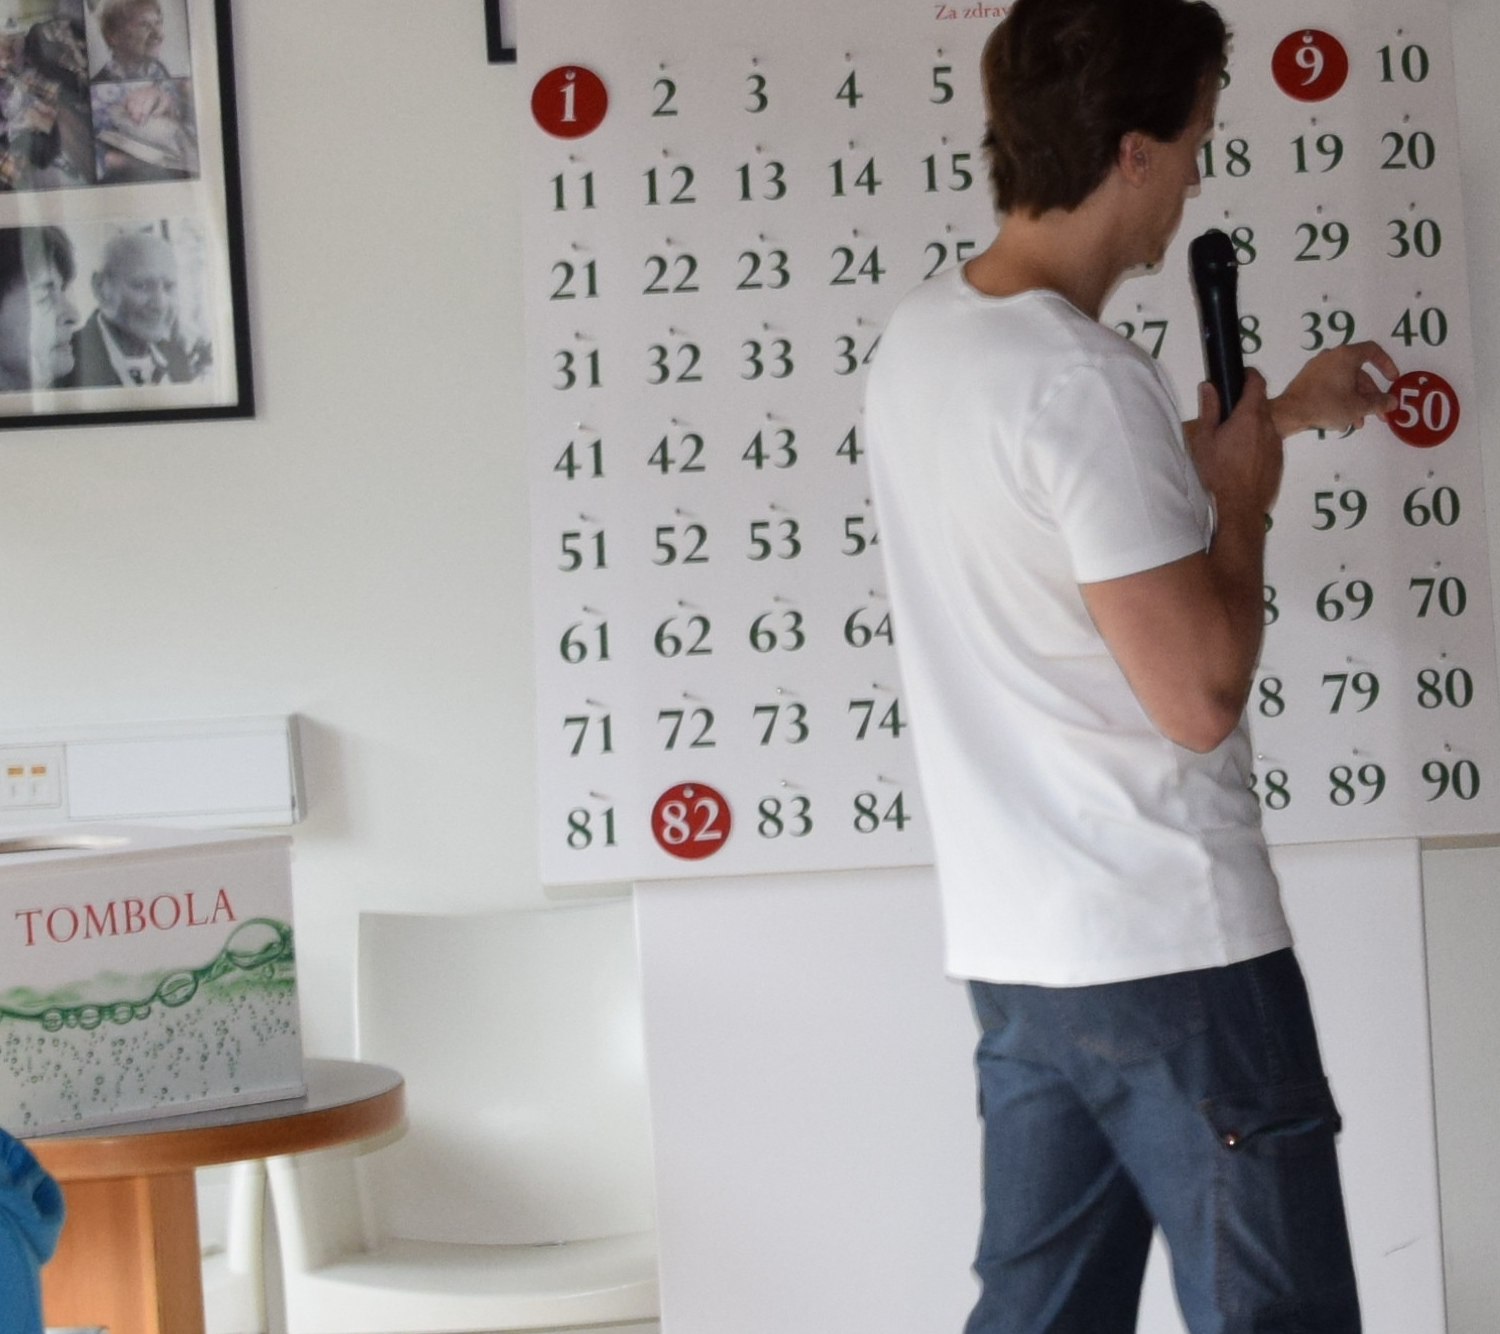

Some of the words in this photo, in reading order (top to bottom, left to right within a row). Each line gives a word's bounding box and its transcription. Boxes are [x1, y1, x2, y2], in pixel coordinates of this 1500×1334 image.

[935, 4, 957, 20] Za
[963, 2, 1009, 18] zdrav
[559, 78, 578, 123] 1
[651, 78, 679, 117] 2
[747, 73, 769, 114] 3
[835, 69, 864, 109] 4
[931, 65, 954, 105] 5
[1295, 45, 1324, 86] 9
[1377, 44, 1430, 83] 10
[551, 170, 596, 212] 11
[644, 164, 697, 206] 12
[736, 161, 787, 201] 13
[829, 156, 882, 197] 14
[922, 152, 973, 193] 15
[1200, 136, 1253, 179] 18
[1291, 133, 1344, 174] 19
[1380, 131, 1436, 170] 20
[550, 259, 598, 301] 21
[642, 253, 700, 295] 22
[736, 249, 791, 291] 23
[829, 245, 887, 286] 24
[1294, 221, 1350, 262] 29
[1387, 218, 1442, 259] 30
[555, 348, 601, 391] 31
[648, 342, 703, 385] 32
[743, 338, 795, 380] 33
[1238, 314, 1264, 355] 8
[1300, 309, 1357, 351] 39
[1390, 306, 1448, 347] 40
[553, 438, 604, 481] 41
[647, 432, 706, 475] 42
[741, 428, 798, 470] 43
[833, 424, 864, 468] 4
[1395, 389, 1452, 431] 50
[561, 530, 606, 572] 51
[655, 523, 710, 566] 52
[749, 518, 802, 561] 53
[842, 513, 879, 558] 5
[1312, 489, 1368, 531] 59
[1402, 486, 1461, 527] 60
[559, 621, 610, 664] 61
[653, 614, 713, 658] 62
[748, 610, 806, 653] 63
[841, 603, 895, 649] 64
[1263, 584, 1280, 626] 8
[1315, 579, 1374, 622] 69
[1408, 576, 1467, 618] 70
[563, 714, 613, 757] 71
[657, 707, 717, 751] 72
[752, 702, 810, 746] 73
[848, 698, 907, 741] 74
[1257, 676, 1286, 719] 8
[1321, 671, 1380, 714] 79
[1416, 667, 1474, 710] 80
[566, 807, 616, 848] 81
[659, 799, 723, 844] 82
[757, 795, 813, 839] 83
[853, 790, 911, 834] 84
[1328, 763, 1386, 807] 89
[1421, 759, 1481, 802] 90
[15, 889, 237, 946] TOMBOLA
